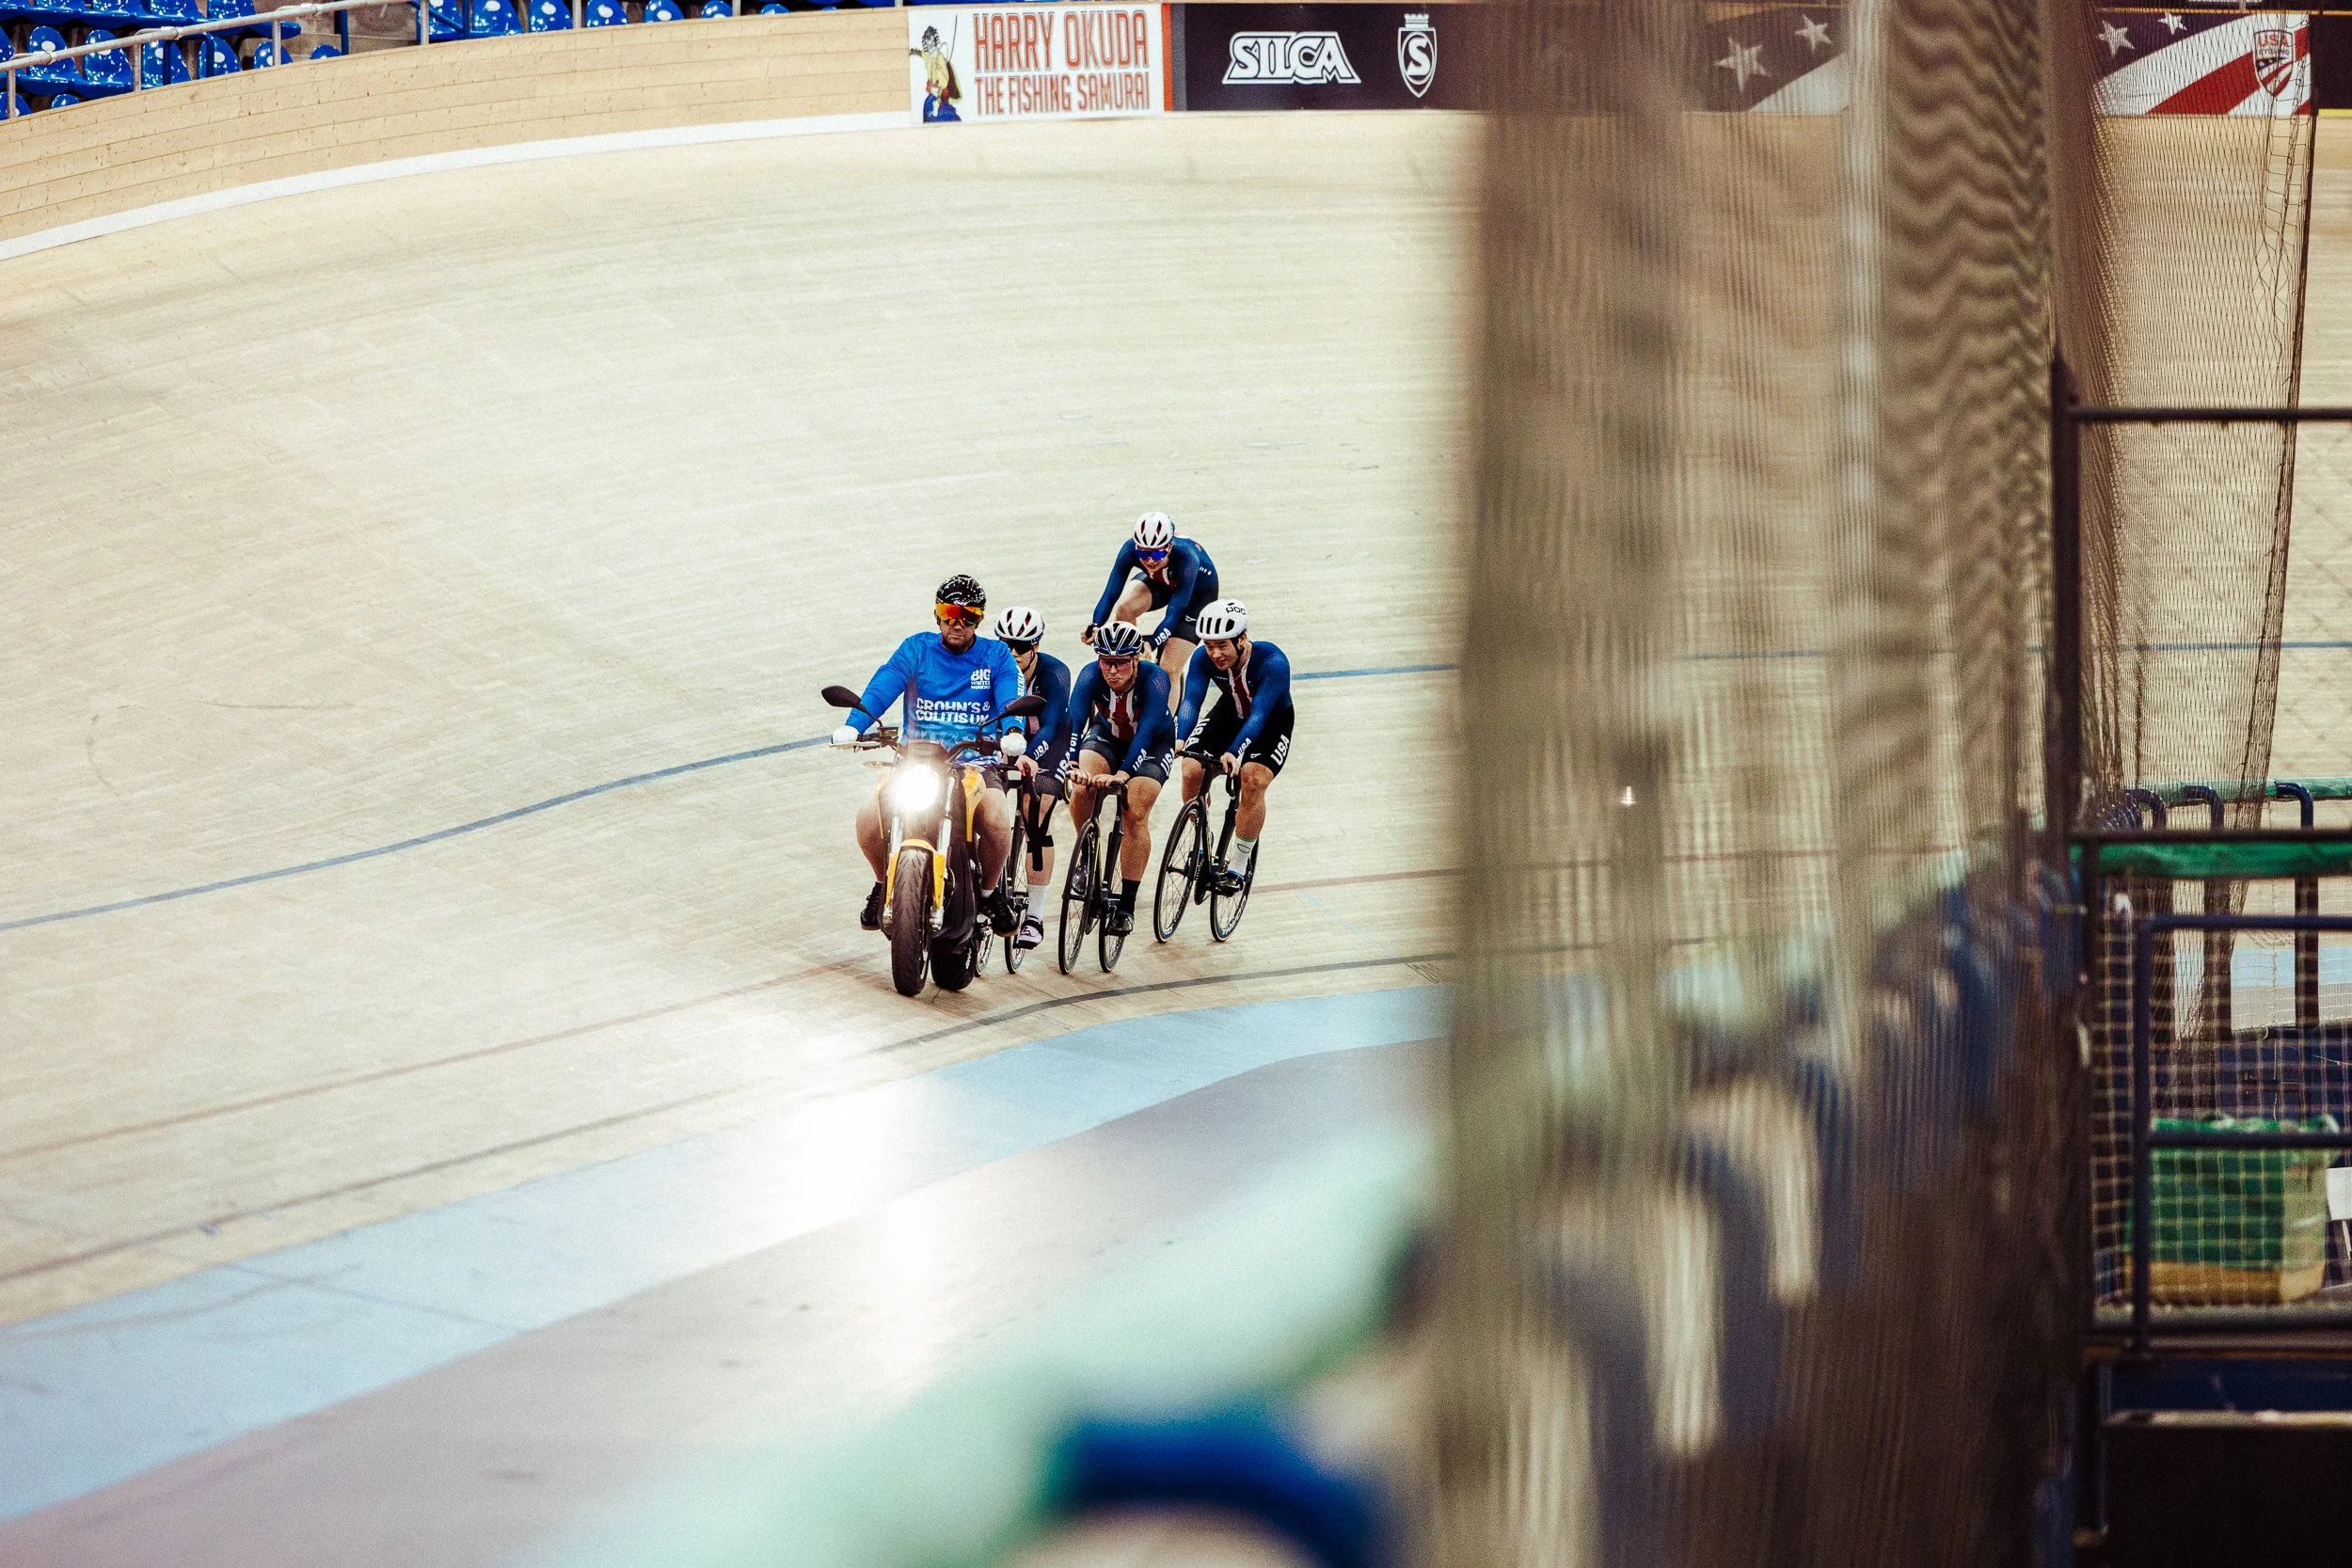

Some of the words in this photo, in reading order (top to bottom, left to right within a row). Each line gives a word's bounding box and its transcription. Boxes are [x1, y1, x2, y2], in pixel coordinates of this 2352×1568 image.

[973, 11, 1054, 72] HARRY
[1063, 9, 1150, 71] OKUDA
[2258, 34, 2289, 47] USA
[1222, 32, 1361, 84] SILCA
[1406, 37, 1432, 76] S
[975, 76, 1004, 115] THE
[1008, 74, 1071, 114] FISHING
[1077, 71, 1150, 111] SAMURAI
[1155, 627, 1172, 645] USA
[970, 668, 991, 681] BIG
[916, 697, 981, 713] CROHN'S
[982, 701, 991, 711] &
[915, 709, 969, 724] COLITIS
[1033, 739, 1049, 760] USA
[1237, 737, 1252, 755] USA
[1271, 734, 1291, 766] USA
[1132, 748, 1148, 771] USA
